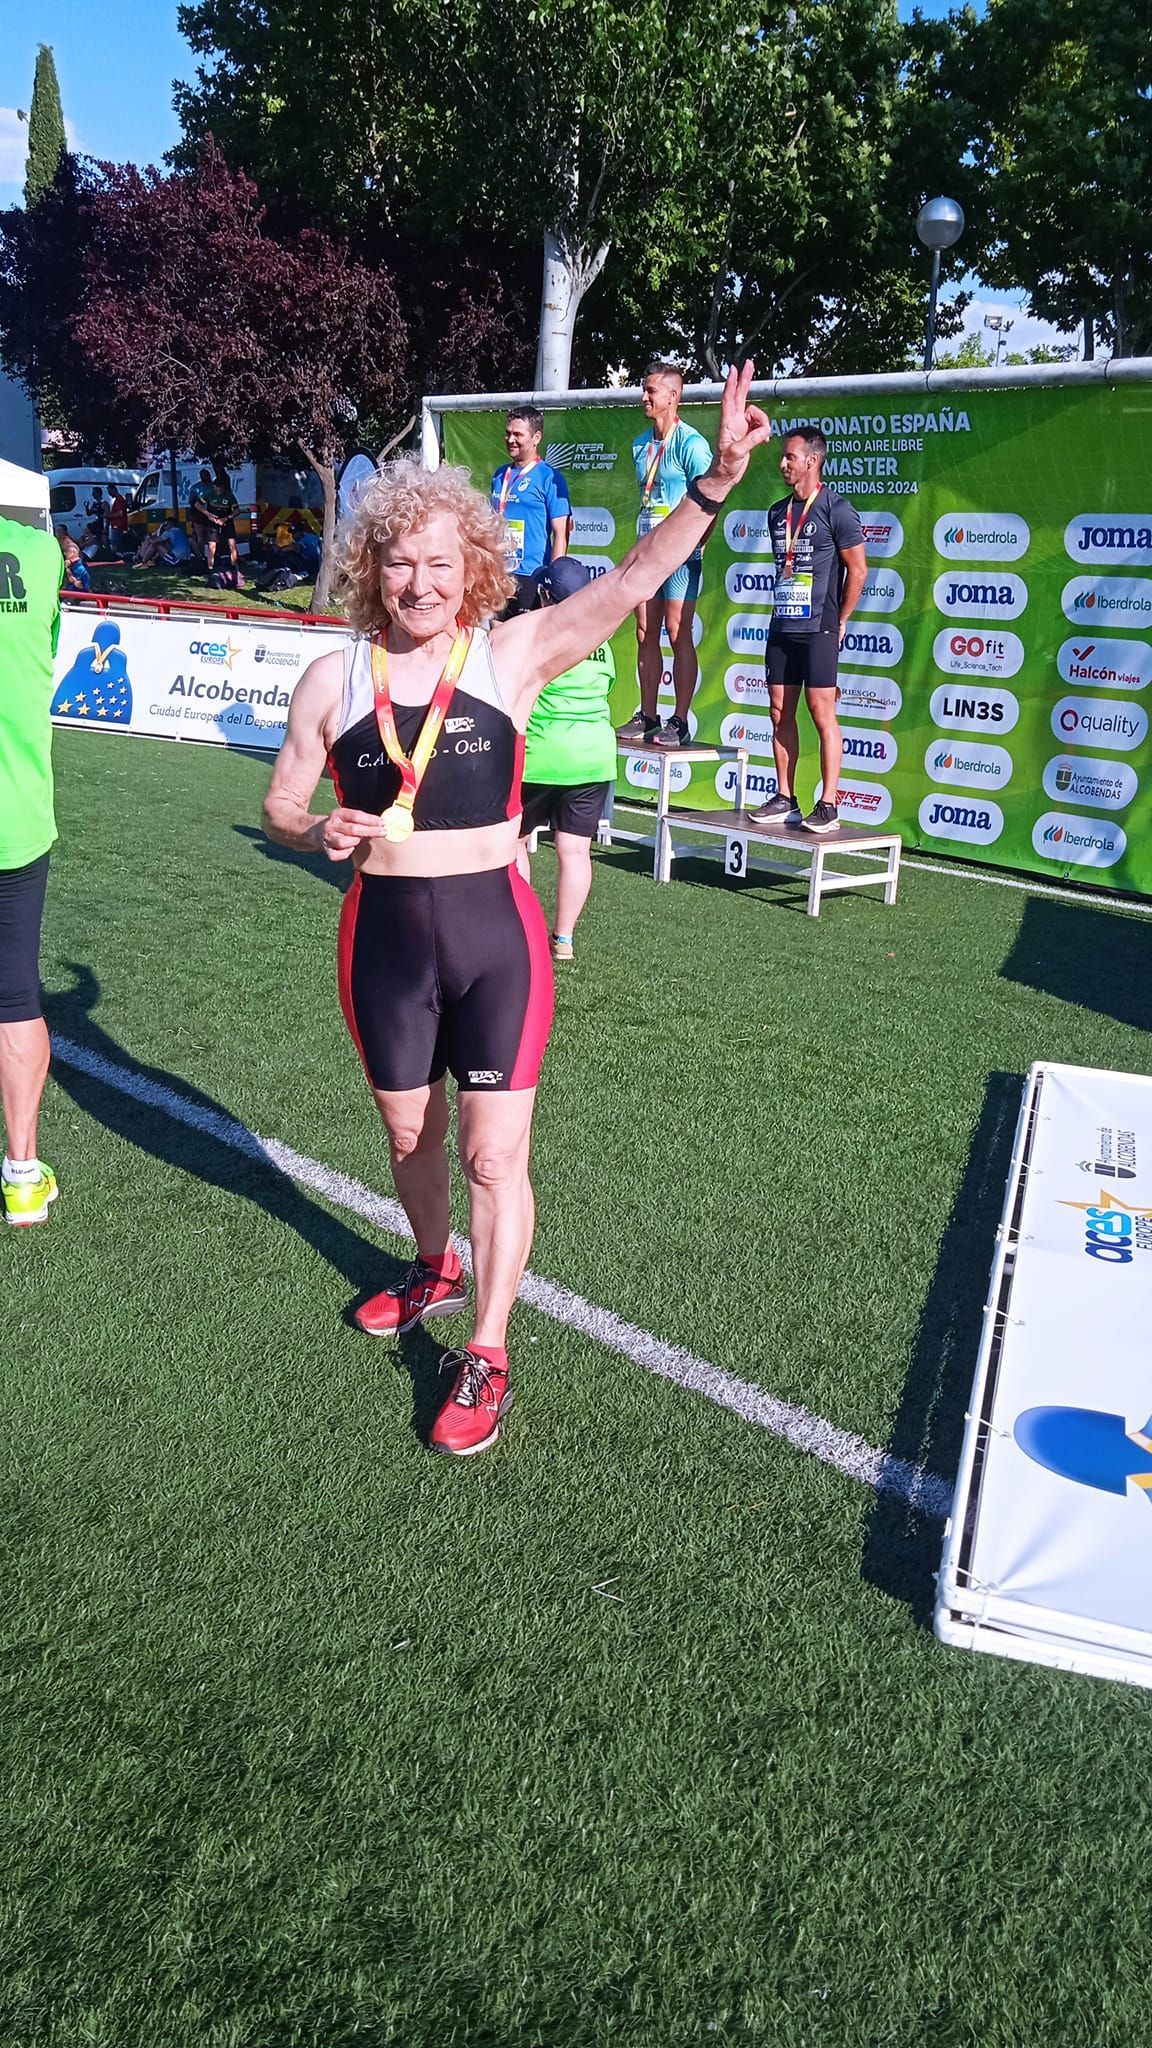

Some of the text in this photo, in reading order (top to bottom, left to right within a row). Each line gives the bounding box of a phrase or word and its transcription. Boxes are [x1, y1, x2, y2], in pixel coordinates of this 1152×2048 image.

[771, 407, 971, 437] AMPEONATO ESPAÑA
[826, 438, 923, 453] TISMO AIRE LIBRE
[822, 456, 898, 476] MASTER
[822, 480, 918, 494] OBENDAS 2024
[576, 523, 608, 533] Iberdrola
[747, 526, 770, 538] Iberd
[966, 531, 1018, 544] Iberdrola
[734, 573, 776, 593] Jom
[861, 585, 894, 597] erdrola
[1, 601, 28, 613] TEAM
[1097, 595, 1152, 611] Iberdrola
[189, 640, 228, 657] aces
[200, 656, 224, 665] EUROPE
[265, 658, 300, 667] ALCOBENDAS
[1069, 664, 1141, 684] Halcón viajes
[168, 674, 291, 707] Alcobenda
[149, 704, 288, 730] Ciudad Europea del Deporte
[943, 697, 1004, 722] LIN3S
[1080, 714, 1140, 737] quality
[745, 729, 774, 743] Iberdr
[455, 737, 492, 755] Ocle
[842, 737, 887, 760] oma
[647, 763, 683, 778] Ibeola
[954, 757, 1001, 775] Iberdrola
[725, 771, 778, 793] Jma
[1072, 772, 1123, 788] Ayuntamiento de
[1069, 784, 1121, 800] ALCOBENDAS
[1063, 831, 1115, 851] Iberdrola
[729, 841, 743, 873] 3
[1117, 1129, 1136, 1169] ALCOBENDAS
[1085, 1207, 1133, 1263] aces
[1135, 1215, 1152, 1250] EUROPE
